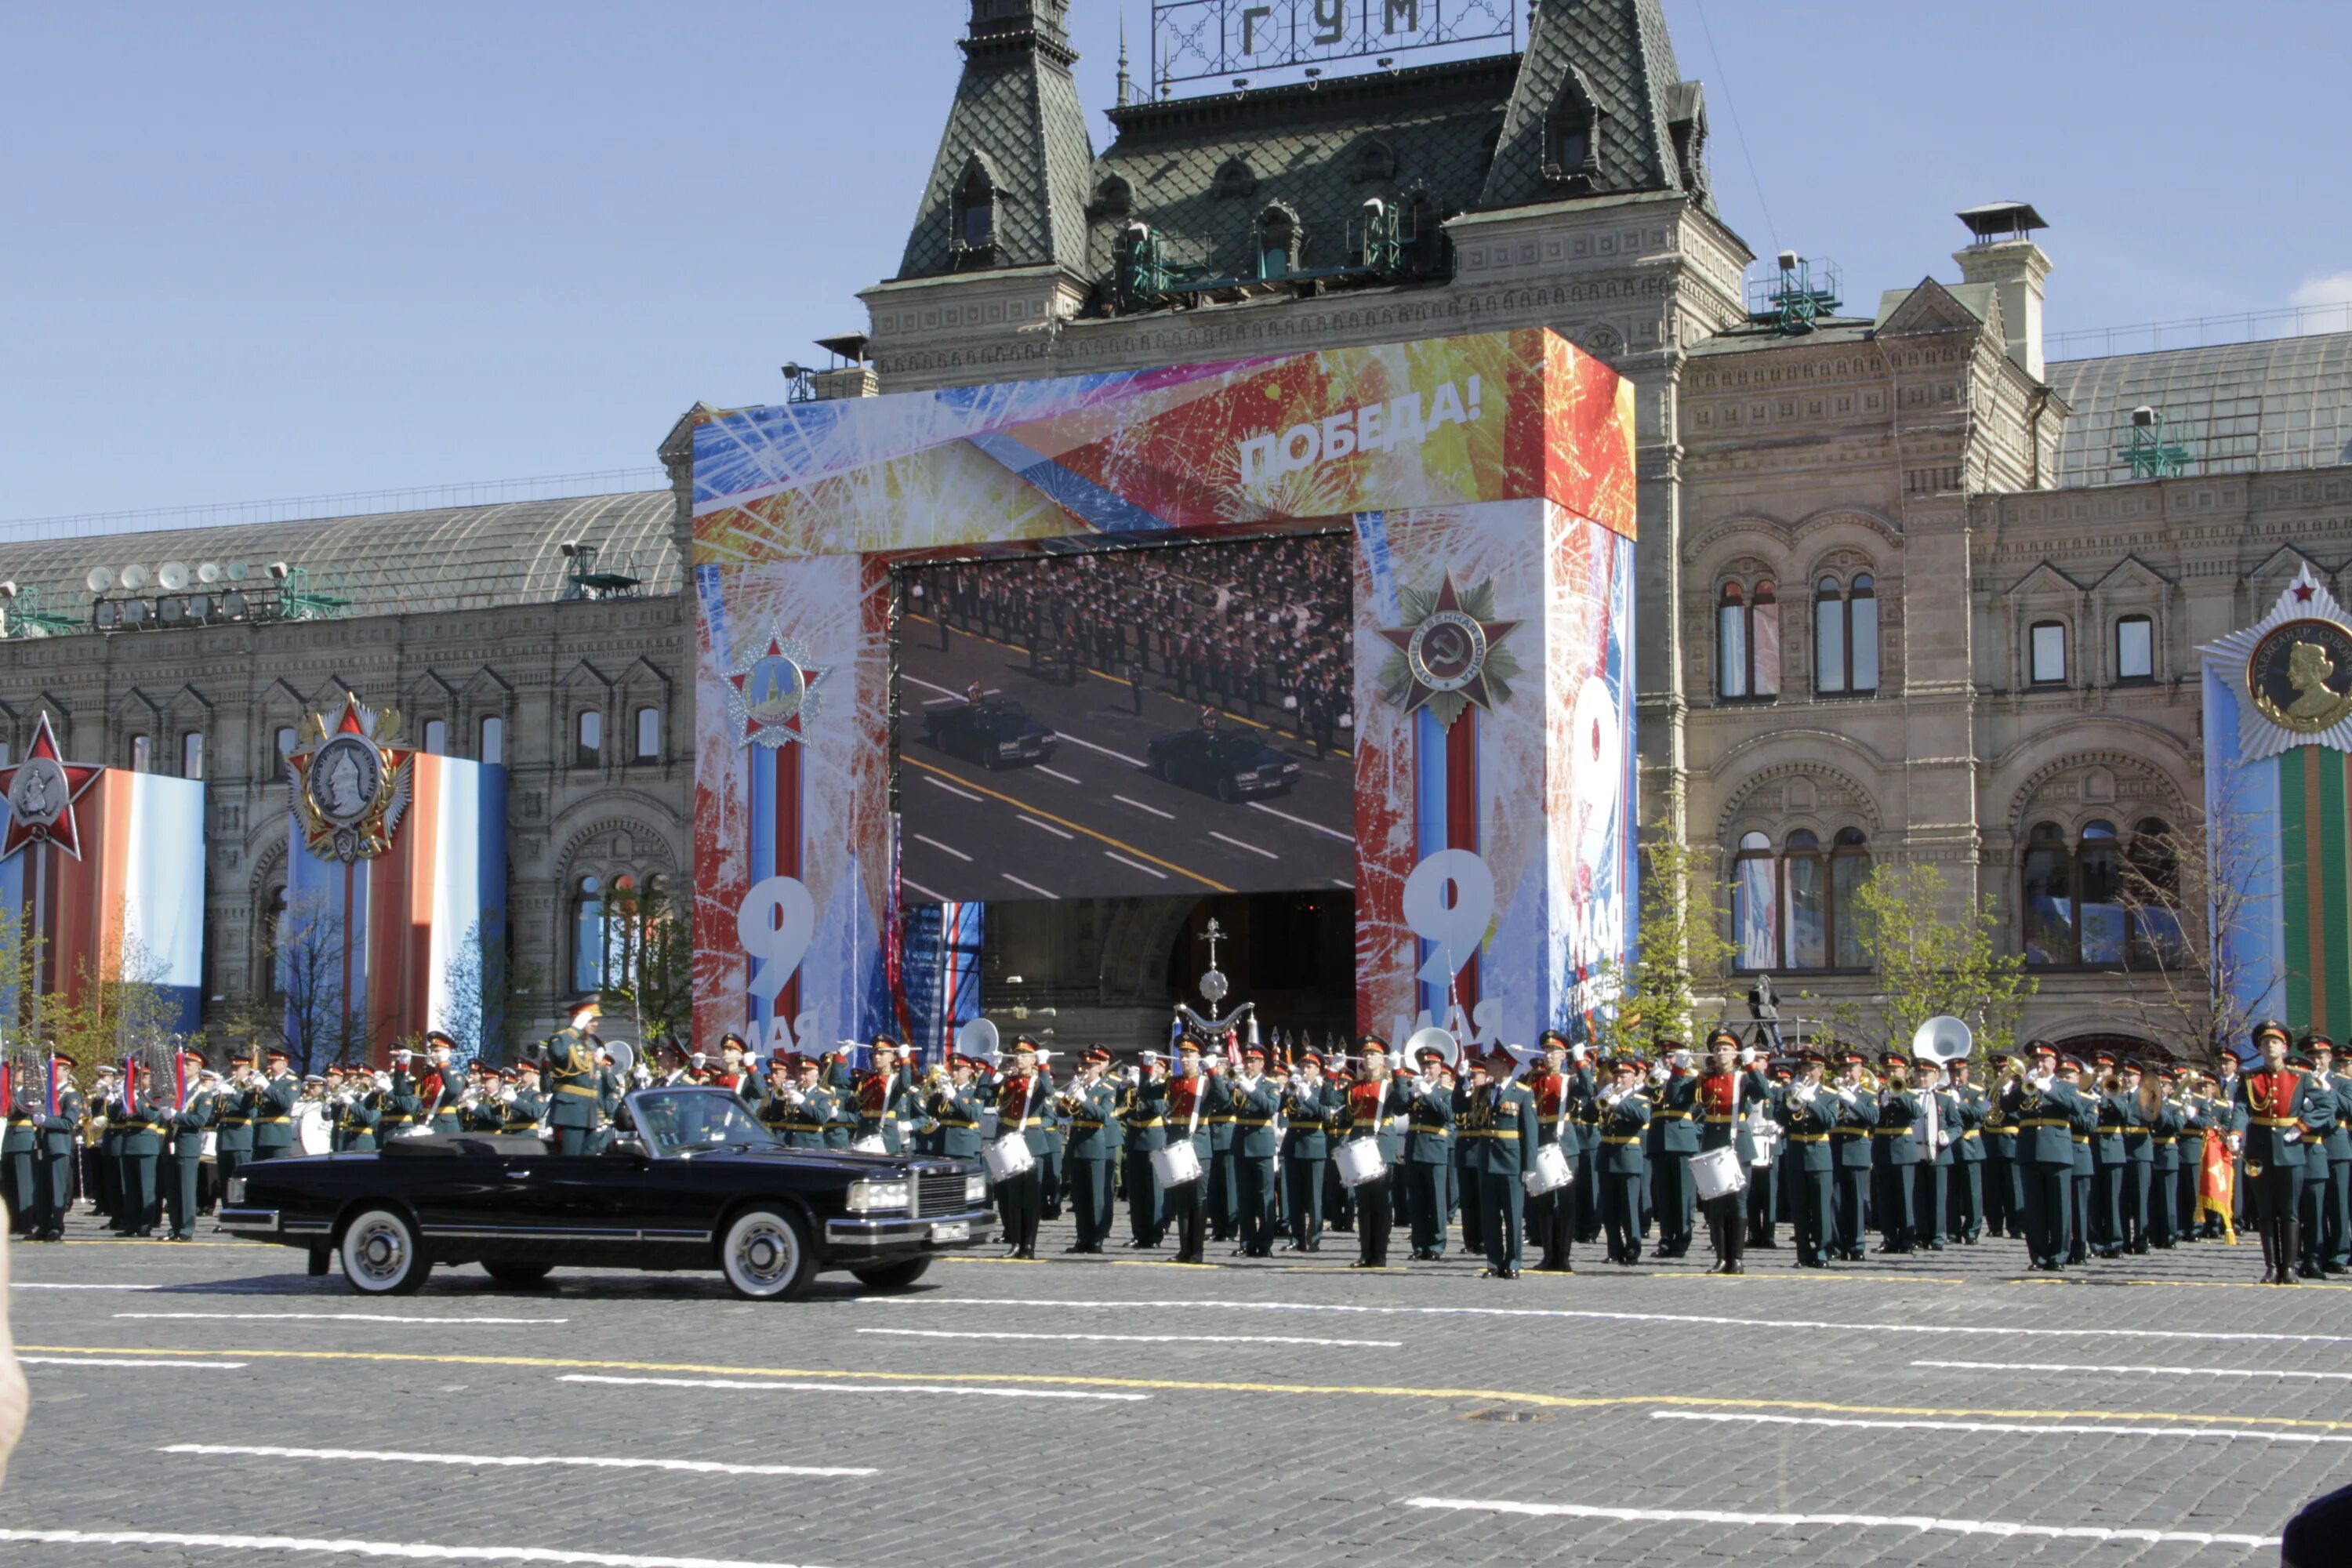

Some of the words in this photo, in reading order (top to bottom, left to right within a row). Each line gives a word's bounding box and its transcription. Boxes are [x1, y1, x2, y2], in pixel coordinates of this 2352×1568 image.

[1243, 0, 1416, 56] ГУМ
[1241, 373, 1482, 486] ПОБЕДА!
[1573, 676, 1620, 873] 9
[737, 876, 815, 1002] 9
[1403, 848, 1495, 987] 9
[1392, 997, 1502, 1054] МАЯ
